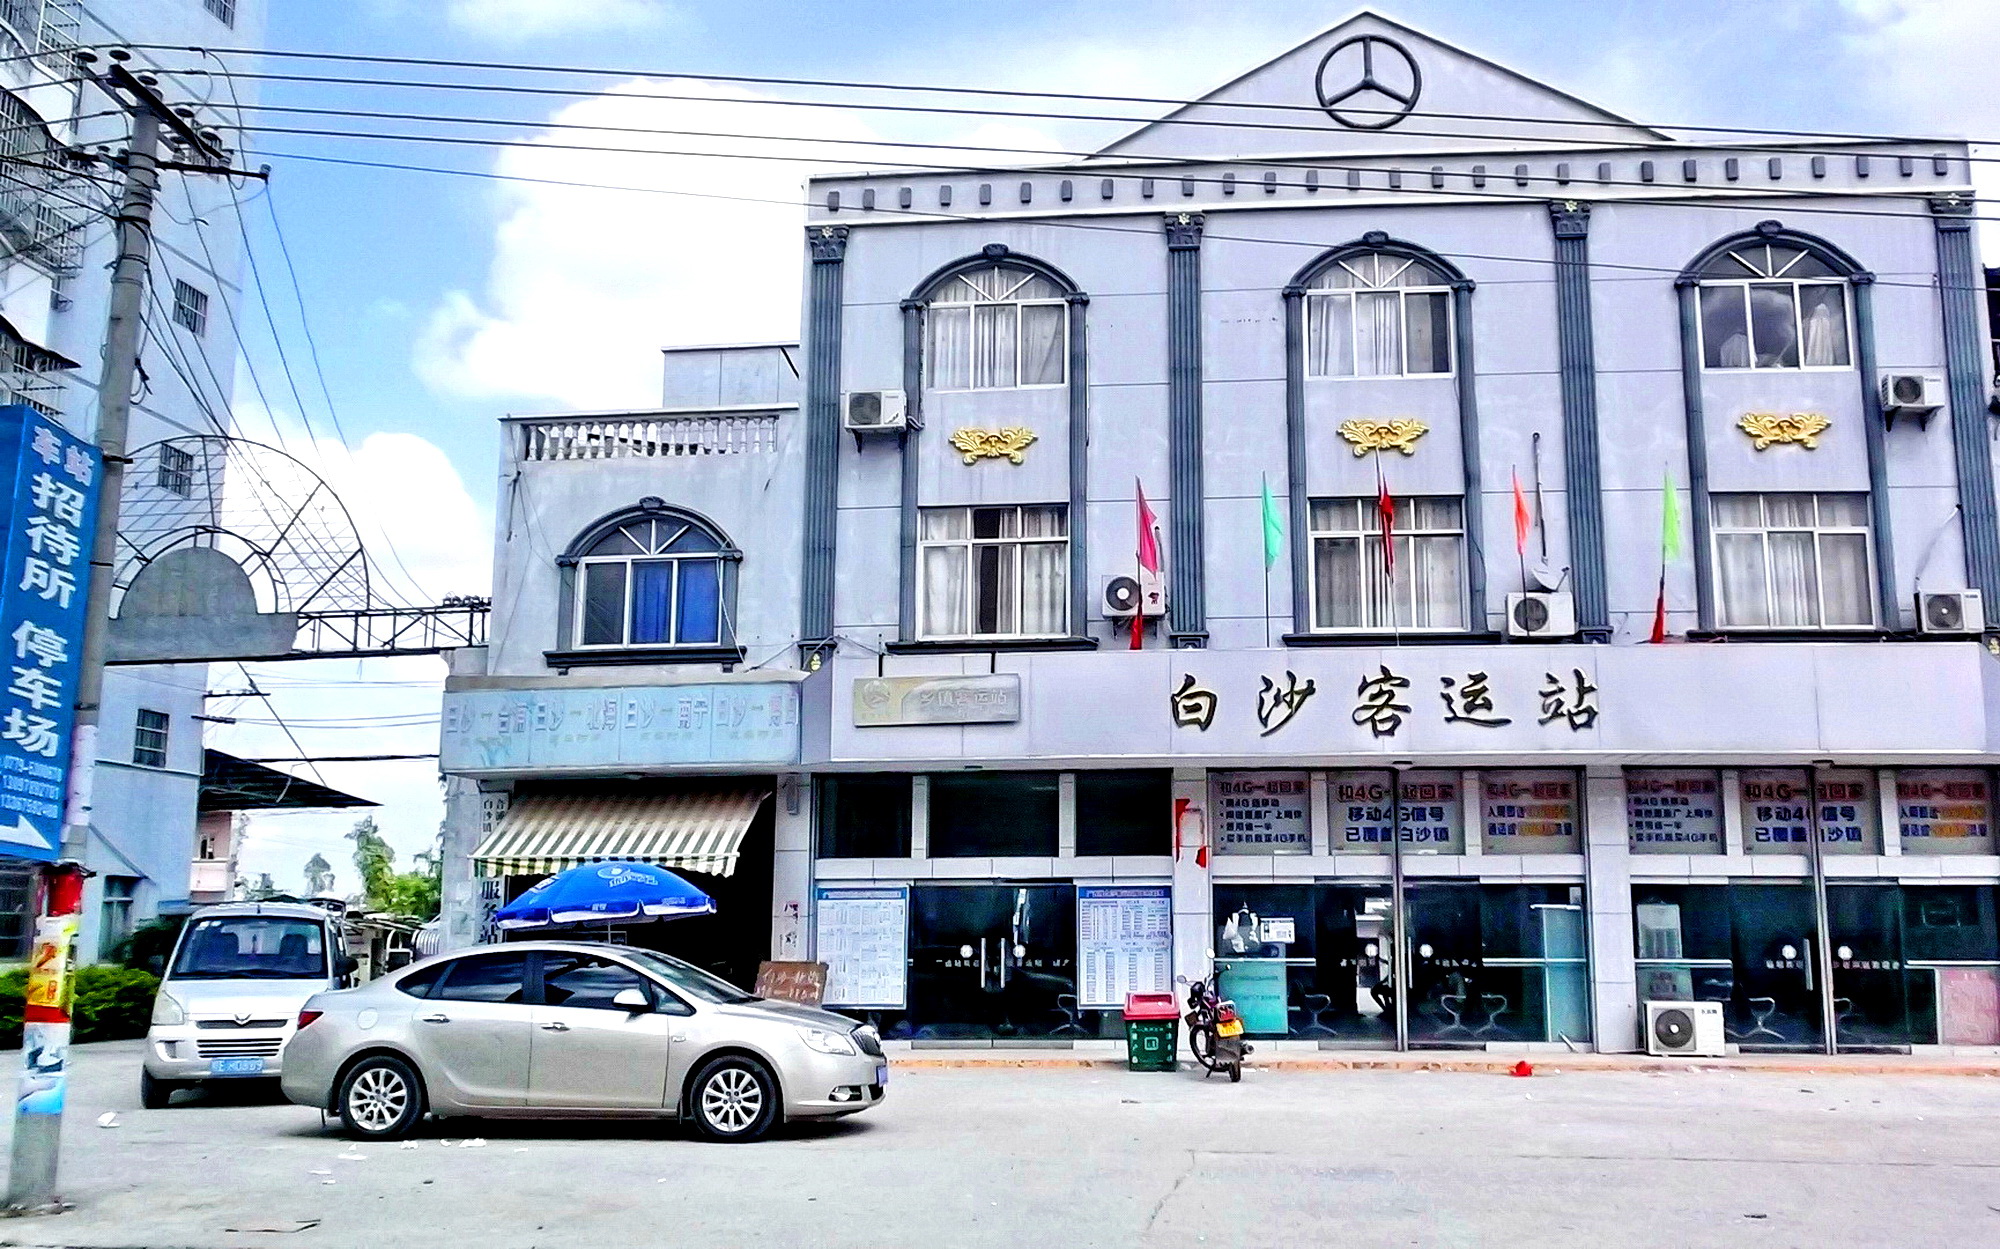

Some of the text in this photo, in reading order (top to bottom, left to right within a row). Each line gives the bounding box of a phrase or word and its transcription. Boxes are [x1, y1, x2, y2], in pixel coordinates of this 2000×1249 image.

[31, 425, 95, 486] 车站
[19, 471, 85, 610] 招待所
[2, 620, 68, 757] 停车场
[1170, 664, 1599, 738] 白沙客运站
[1347, 806, 1444, 821] 移动4G信号
[478, 880, 501, 944] 服务站
